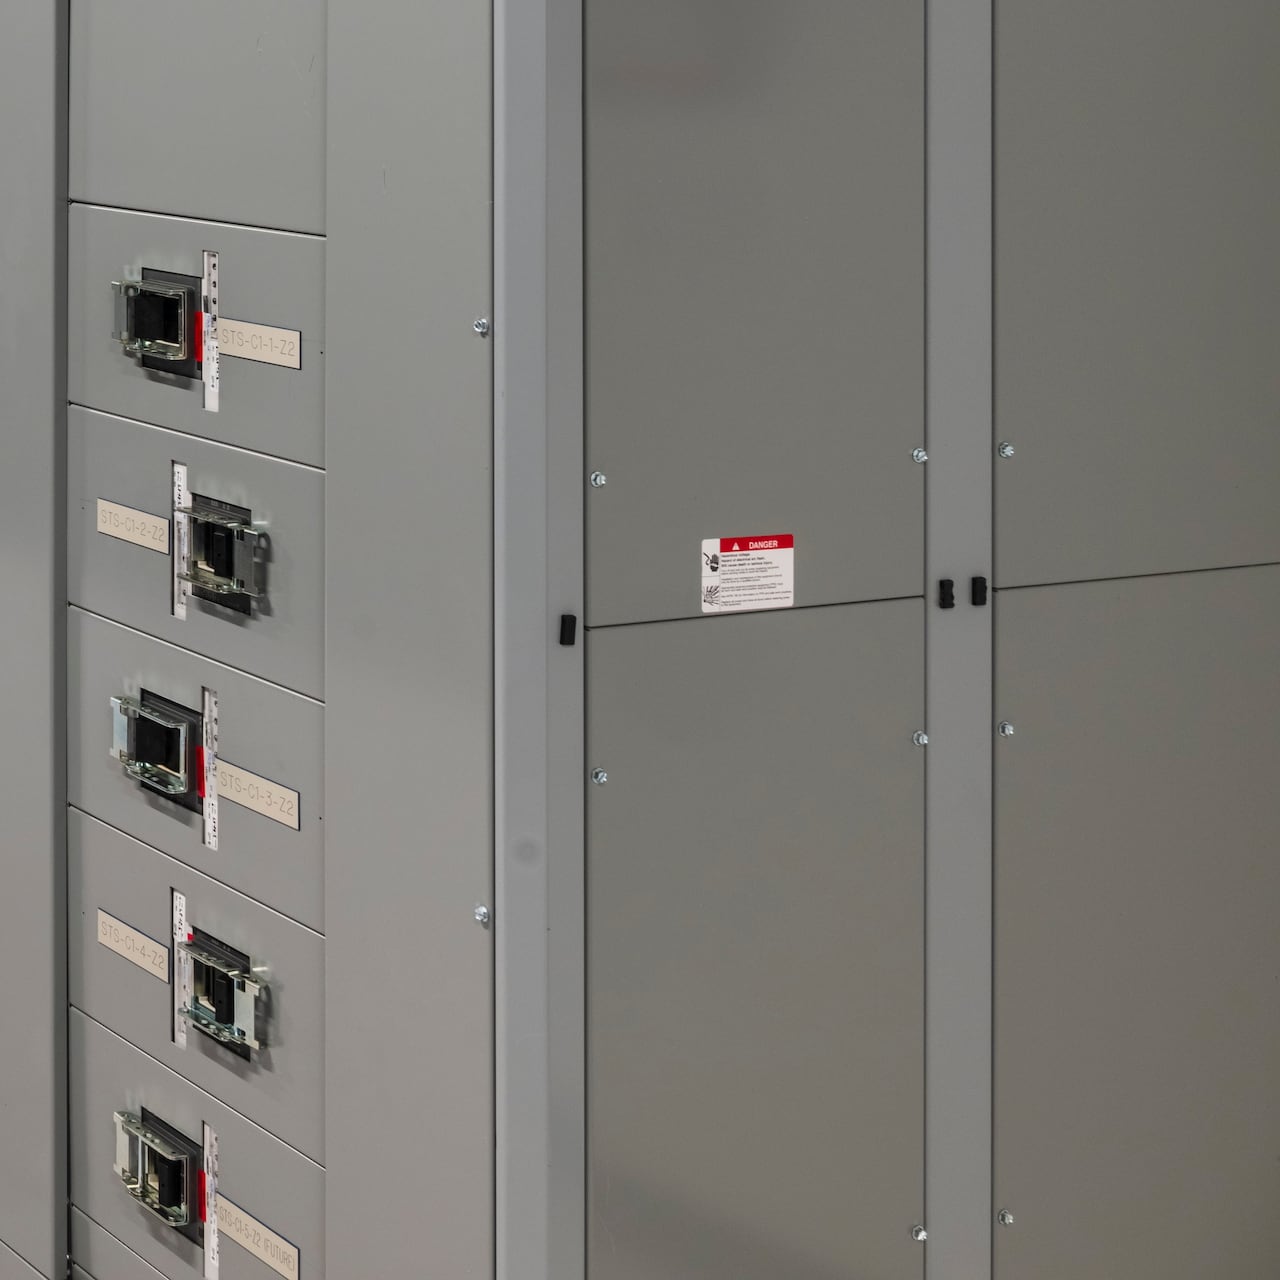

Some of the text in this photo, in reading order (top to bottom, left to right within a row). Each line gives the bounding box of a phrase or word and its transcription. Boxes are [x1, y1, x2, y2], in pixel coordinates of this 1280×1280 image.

[222, 328, 295, 357] STS-C1-1-Z2
[101, 509, 165, 543] STS-C1-2-Z2
[748, 540, 778, 550] DANGER
[220, 771, 294, 817] STS-C1-3-Z2
[101, 921, 165, 970] STS-C1-4-Z2
[219, 1206, 296, 1272] STS-C1-5-Z2 (FUTURE)
